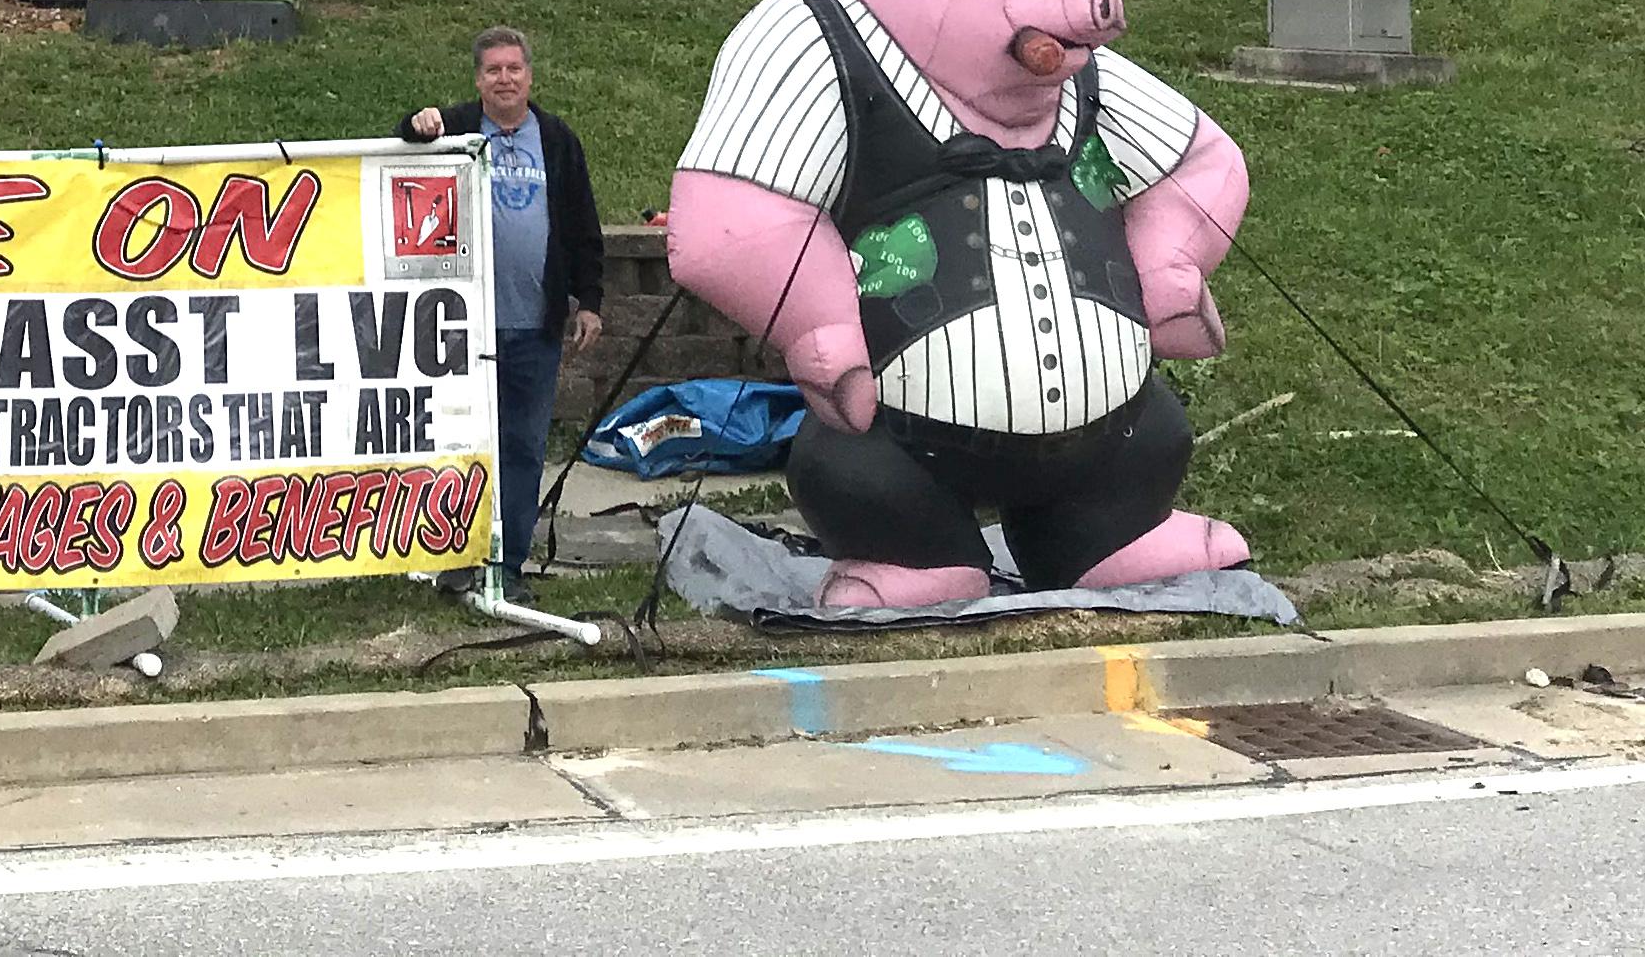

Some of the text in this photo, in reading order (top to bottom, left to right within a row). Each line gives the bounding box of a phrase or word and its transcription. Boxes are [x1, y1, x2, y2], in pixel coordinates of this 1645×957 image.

[92, 170, 321, 280] ON
[907, 220, 927, 243] 100
[862, 280, 883, 292] 100
[896, 265, 917, 279] 100
[294, 287, 468, 381] LVG
[221, 389, 328, 460] THAT
[355, 385, 435, 455] ARE
[138, 481, 187, 567] &
[201, 462, 488, 568] BENEFITS!
